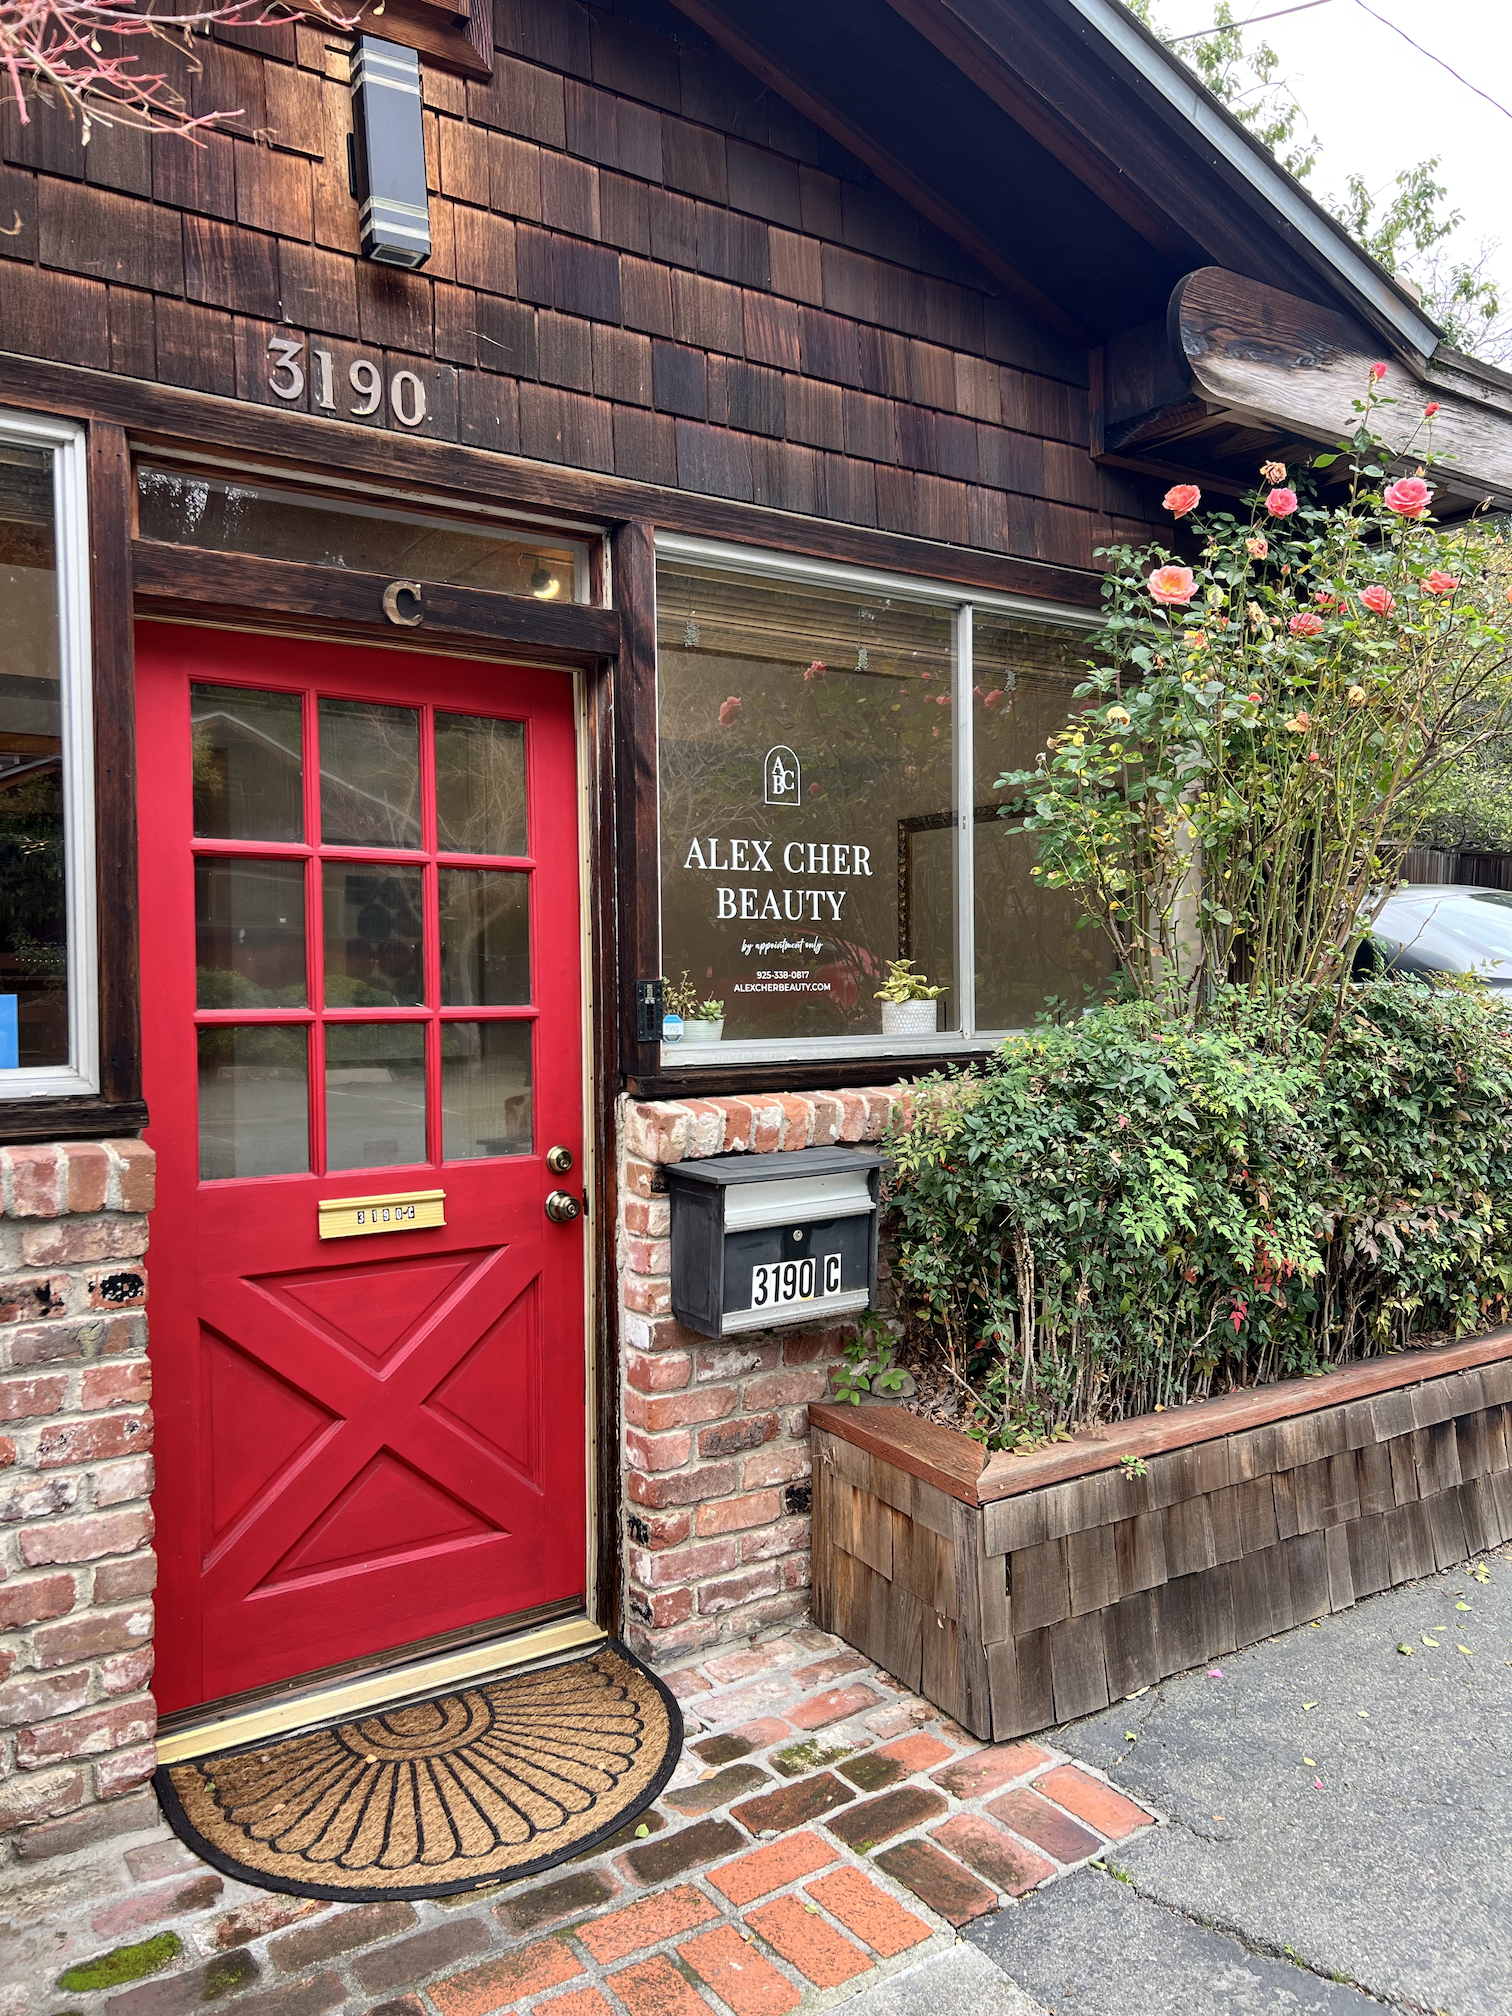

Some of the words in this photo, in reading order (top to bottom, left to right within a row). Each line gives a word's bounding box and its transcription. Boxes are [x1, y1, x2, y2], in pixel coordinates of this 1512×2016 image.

[268, 336, 427, 427] 3190
[382, 580, 424, 627] C
[683, 836, 774, 872] ALEX
[783, 841, 873, 876] CHER
[716, 887, 847, 921] BEAUTY
[741, 938, 754, 956] by
[754, 937, 805, 956] appointment
[805, 935, 823, 955] only
[733, 982, 831, 993] ALEXCHERBEAUTY.COM
[756, 970, 810, 980] 925-338-0817
[754, 1260, 813, 1306] 3190
[826, 1256, 840, 1292] C
